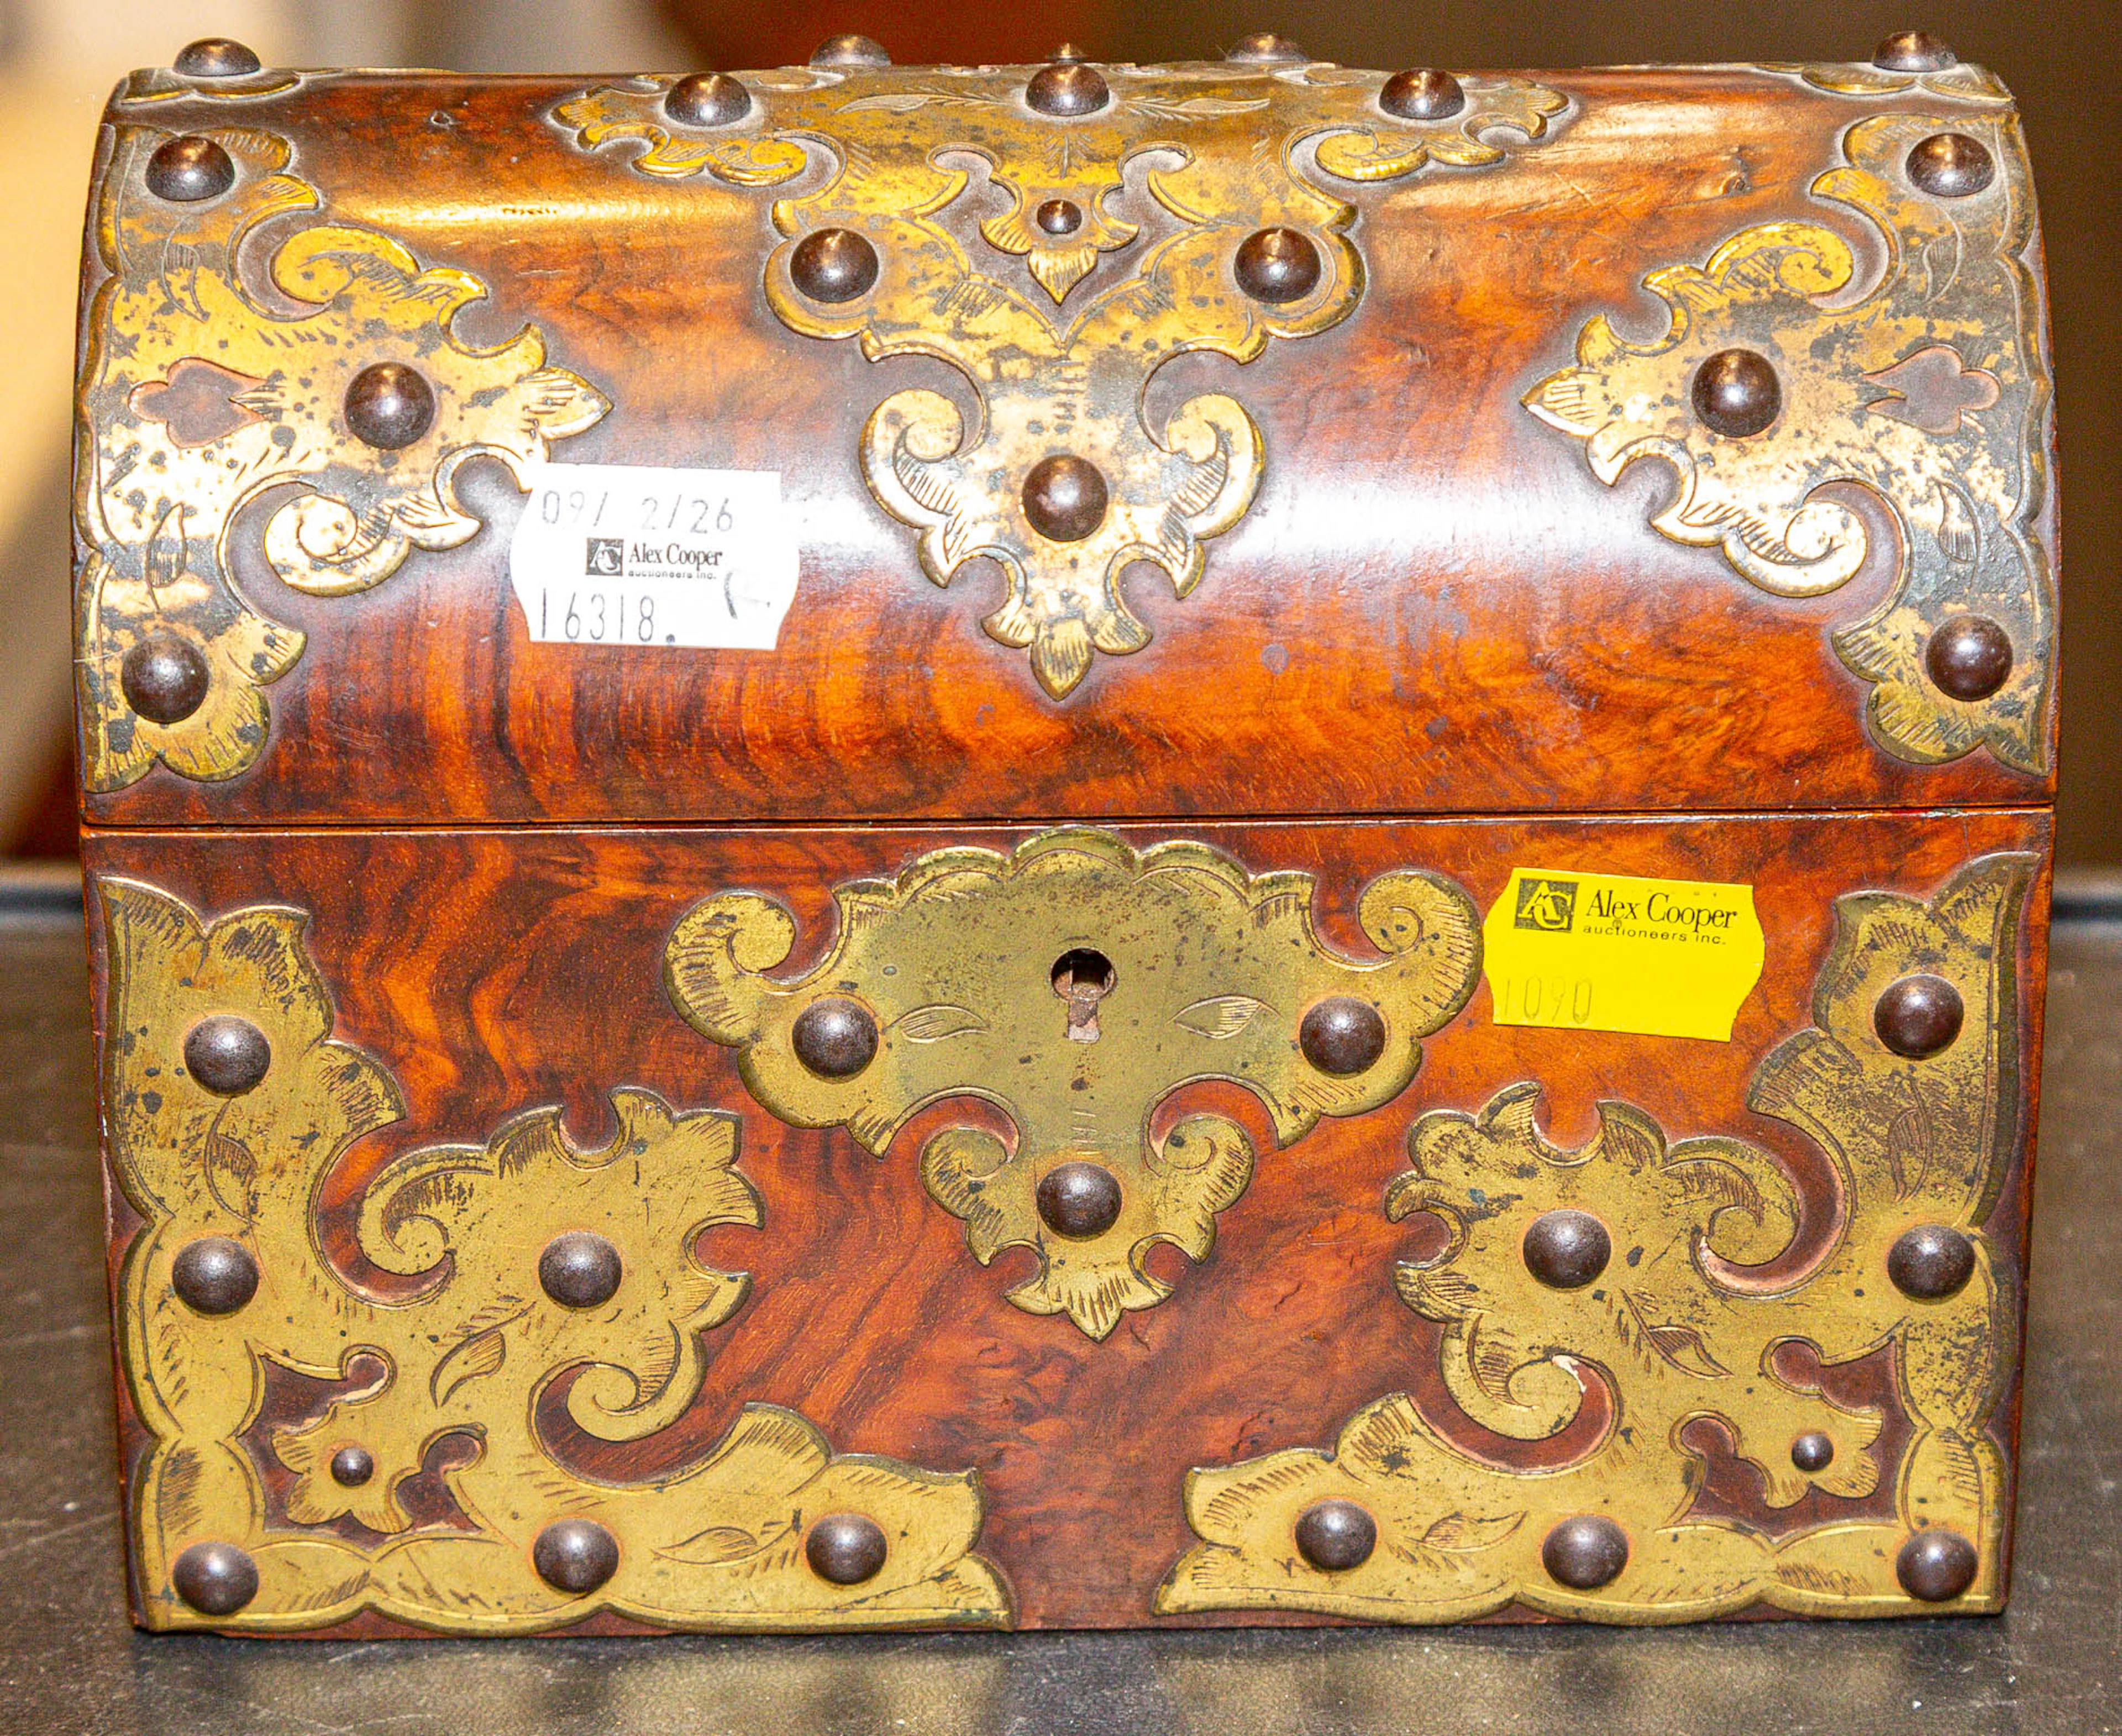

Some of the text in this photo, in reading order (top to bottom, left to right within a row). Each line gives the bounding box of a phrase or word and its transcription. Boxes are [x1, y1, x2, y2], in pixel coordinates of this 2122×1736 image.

[628, 542, 723, 571] Alex Cooper
[1585, 889, 1737, 933] Alex Cooper
[1583, 924, 1726, 945] auctioneers inc.
